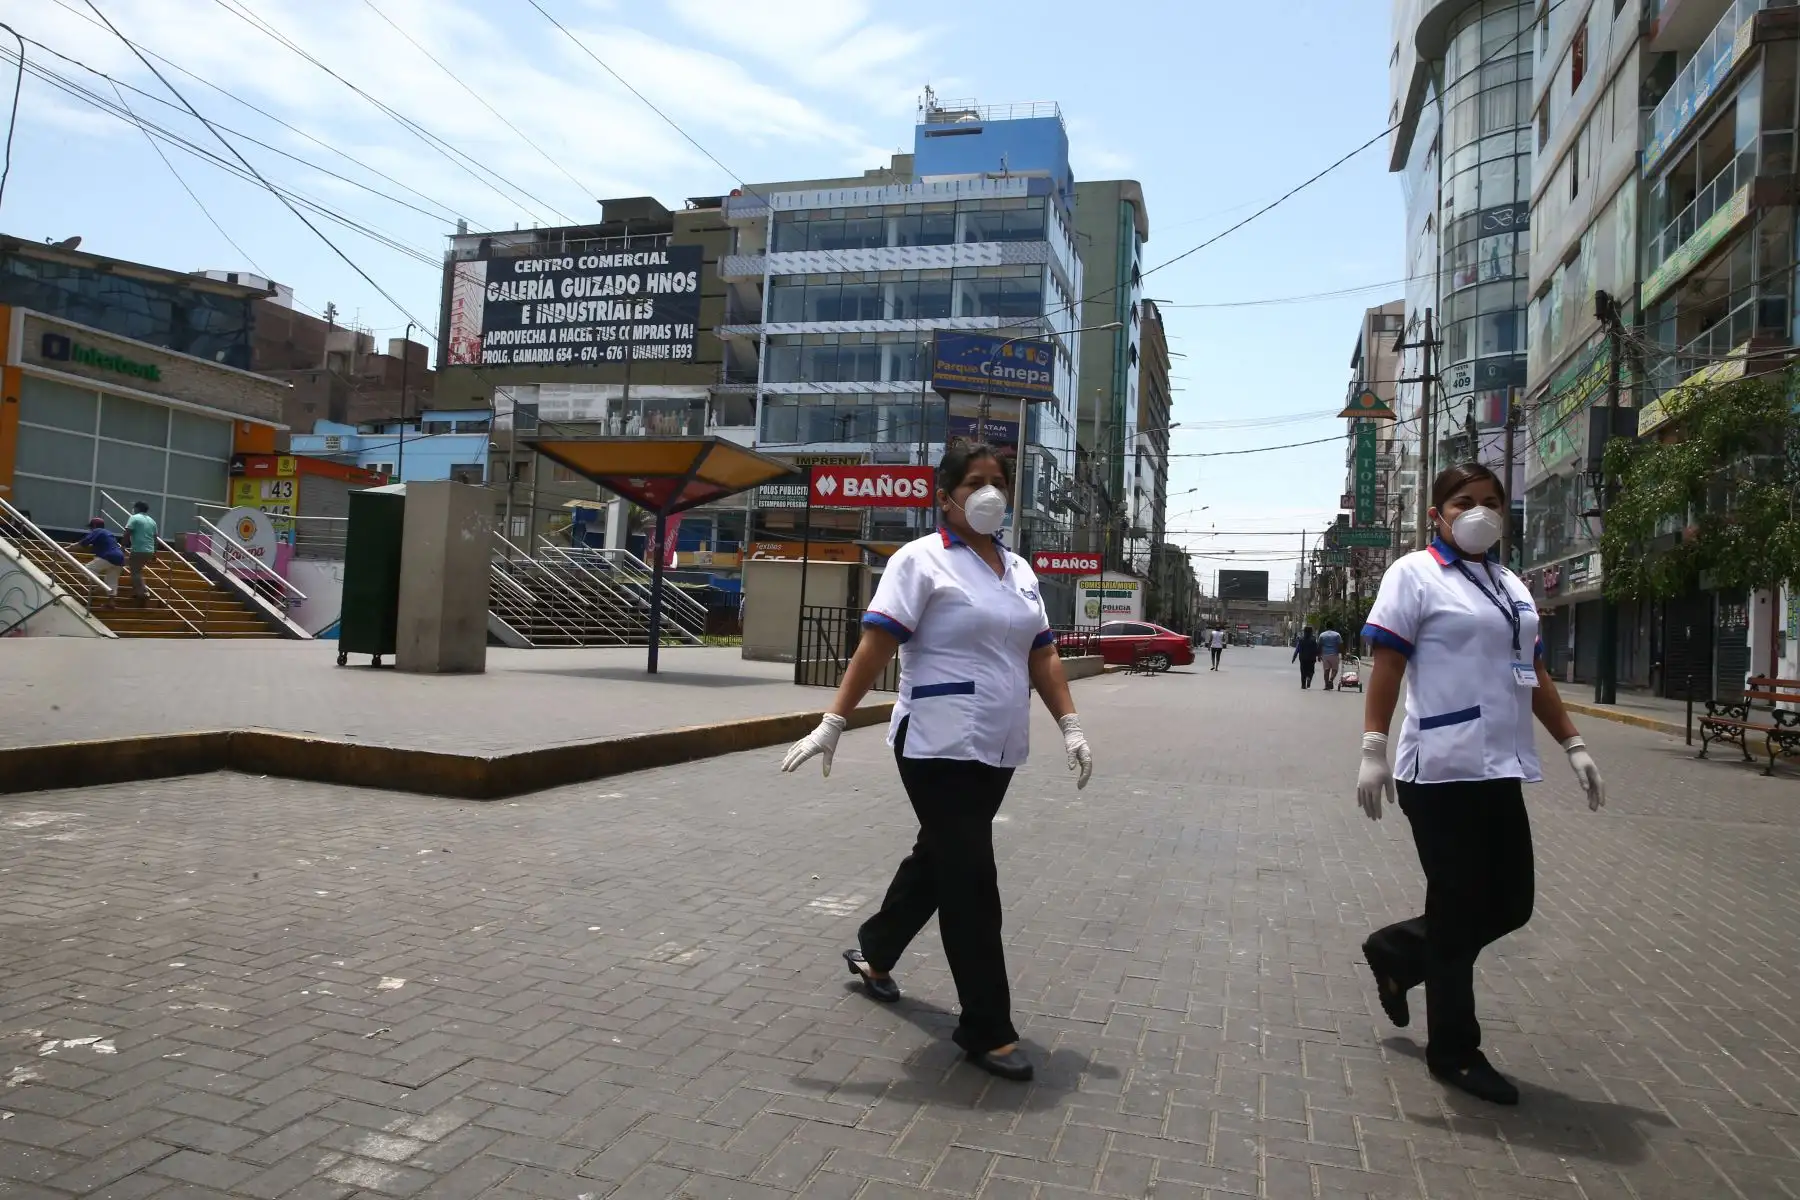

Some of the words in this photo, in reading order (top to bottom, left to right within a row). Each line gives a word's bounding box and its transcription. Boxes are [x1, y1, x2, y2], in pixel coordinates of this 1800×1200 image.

[515, 257, 574, 273] CENTRO
[578, 252, 669, 269] COMERCIAL
[487, 273, 555, 302] GALERÍA
[561, 274, 641, 299] GUIZADO
[646, 271, 697, 293] HNOS
[521, 304, 531, 325] E
[536, 299, 654, 324] INDUSTRIALES
[549, 328, 557, 343] A
[559, 327, 593, 342] HACER
[596, 326, 617, 341] TUS
[674, 323, 694, 339] YA!
[482, 350, 511, 364] PROLG.
[513, 348, 554, 363] GAMARRA
[556, 347, 573, 361] 654
[581, 346, 598, 360] 674
[606, 345, 623, 360] 676
[671, 344, 693, 359] 1593
[936, 360, 979, 376] Parque
[980, 361, 1051, 384] Cánepa
[1453, 376, 1471, 388] 409
[271, 481, 293, 498] 43
[759, 485, 779, 495] POLOS
[843, 474, 929, 498] BAÑOS
[1051, 557, 1098, 569] BAÑOS
